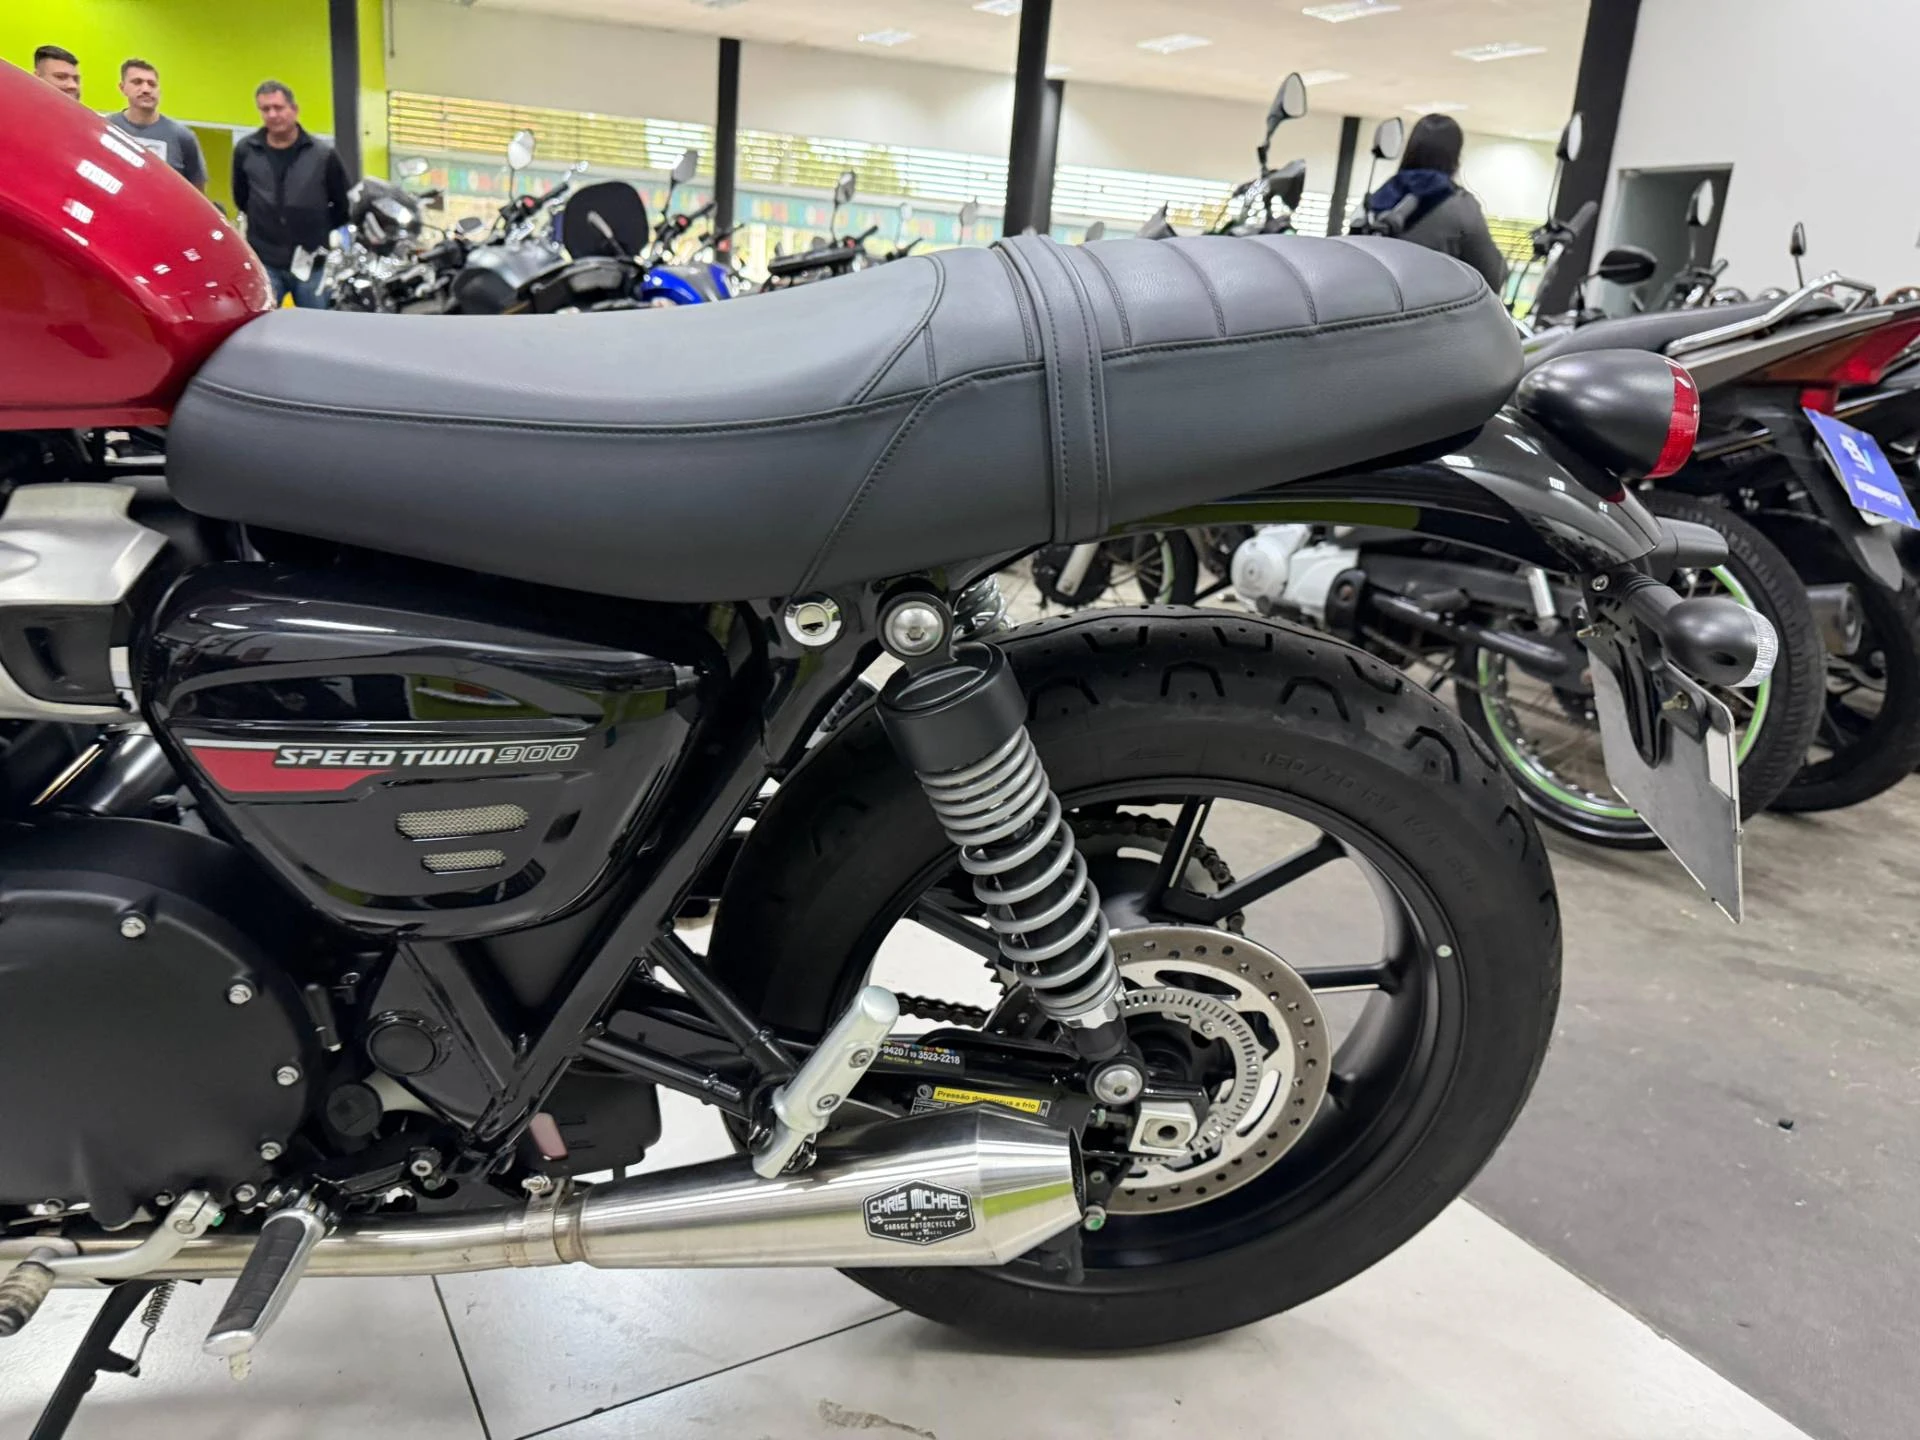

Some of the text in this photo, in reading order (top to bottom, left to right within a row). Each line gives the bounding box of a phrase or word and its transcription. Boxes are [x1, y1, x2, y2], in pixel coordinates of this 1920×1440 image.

[275, 743, 581, 767] SPEED TWIN 900
[917, 1051, 961, 1065] 3523-2218
[869, 1188, 968, 1215] CHRIS MICHAEL
[910, 1220, 956, 1230] MOTORCYCLES
